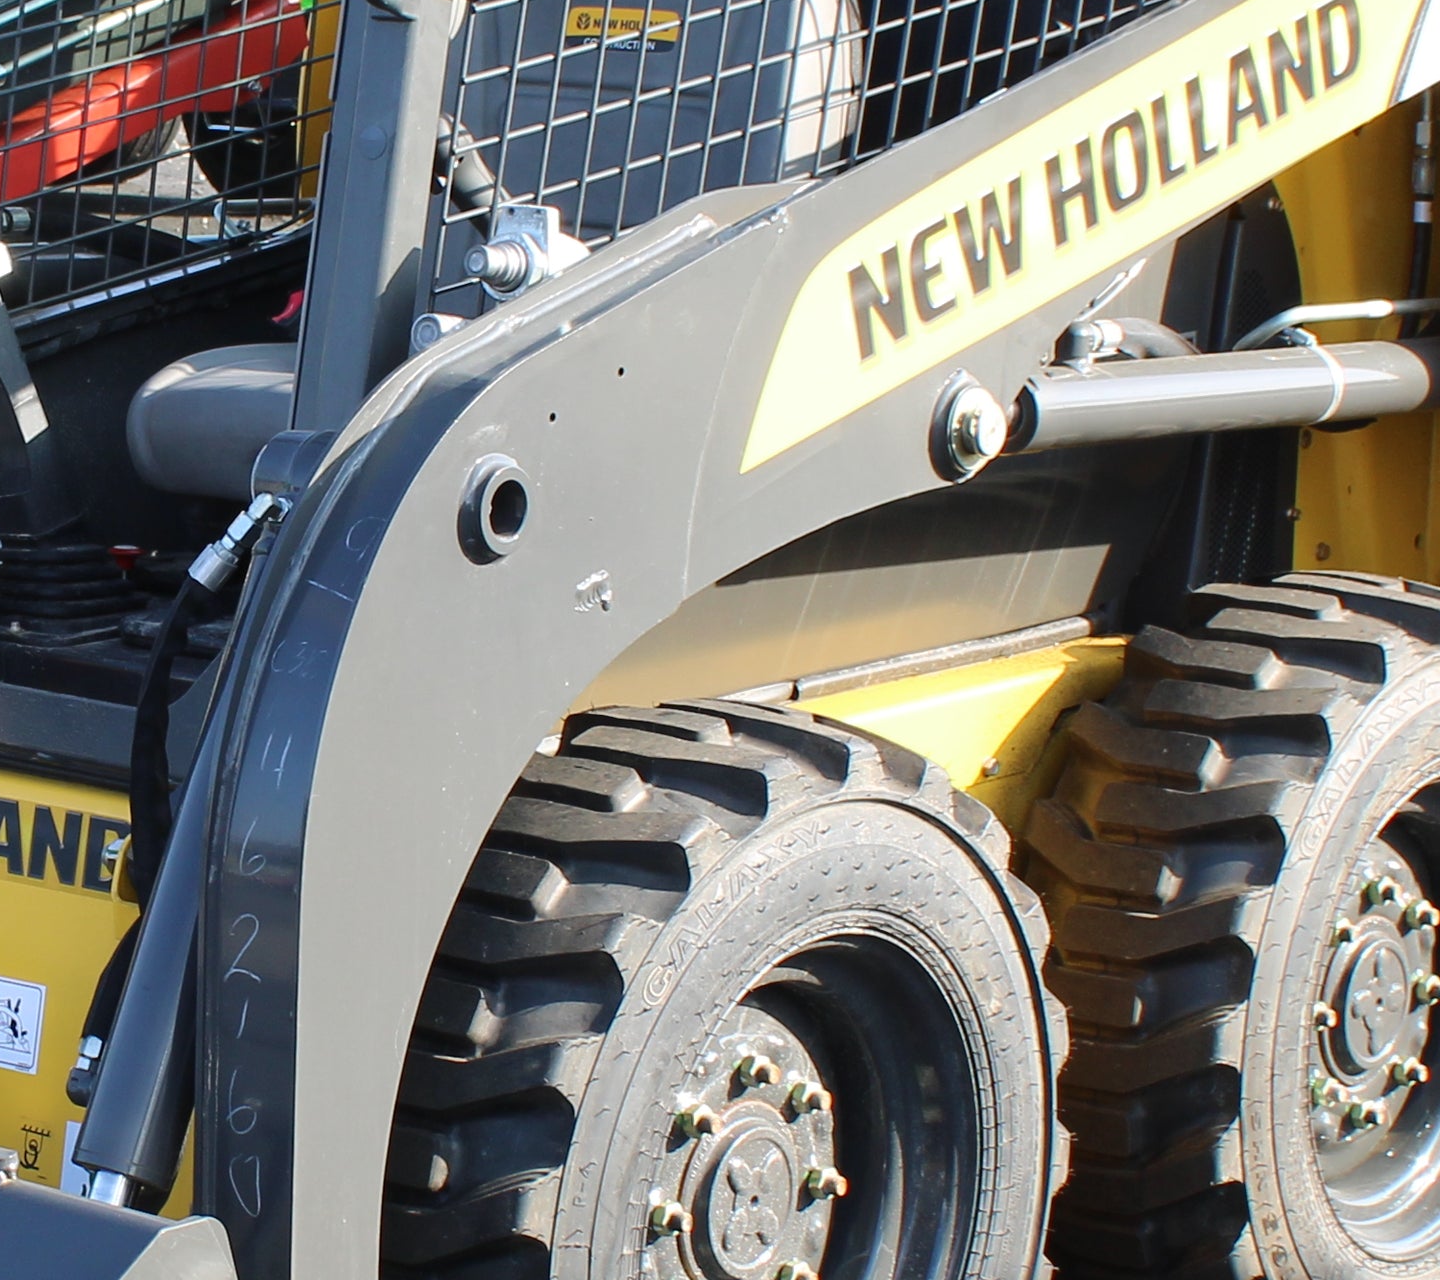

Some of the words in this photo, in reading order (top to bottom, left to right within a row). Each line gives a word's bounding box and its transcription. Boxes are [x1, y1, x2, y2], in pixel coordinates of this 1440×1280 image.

[847, 172, 1022, 363] NEW
[1295, 675, 1432, 865] GALAXY
[642, 819, 826, 1007] GALAXY
